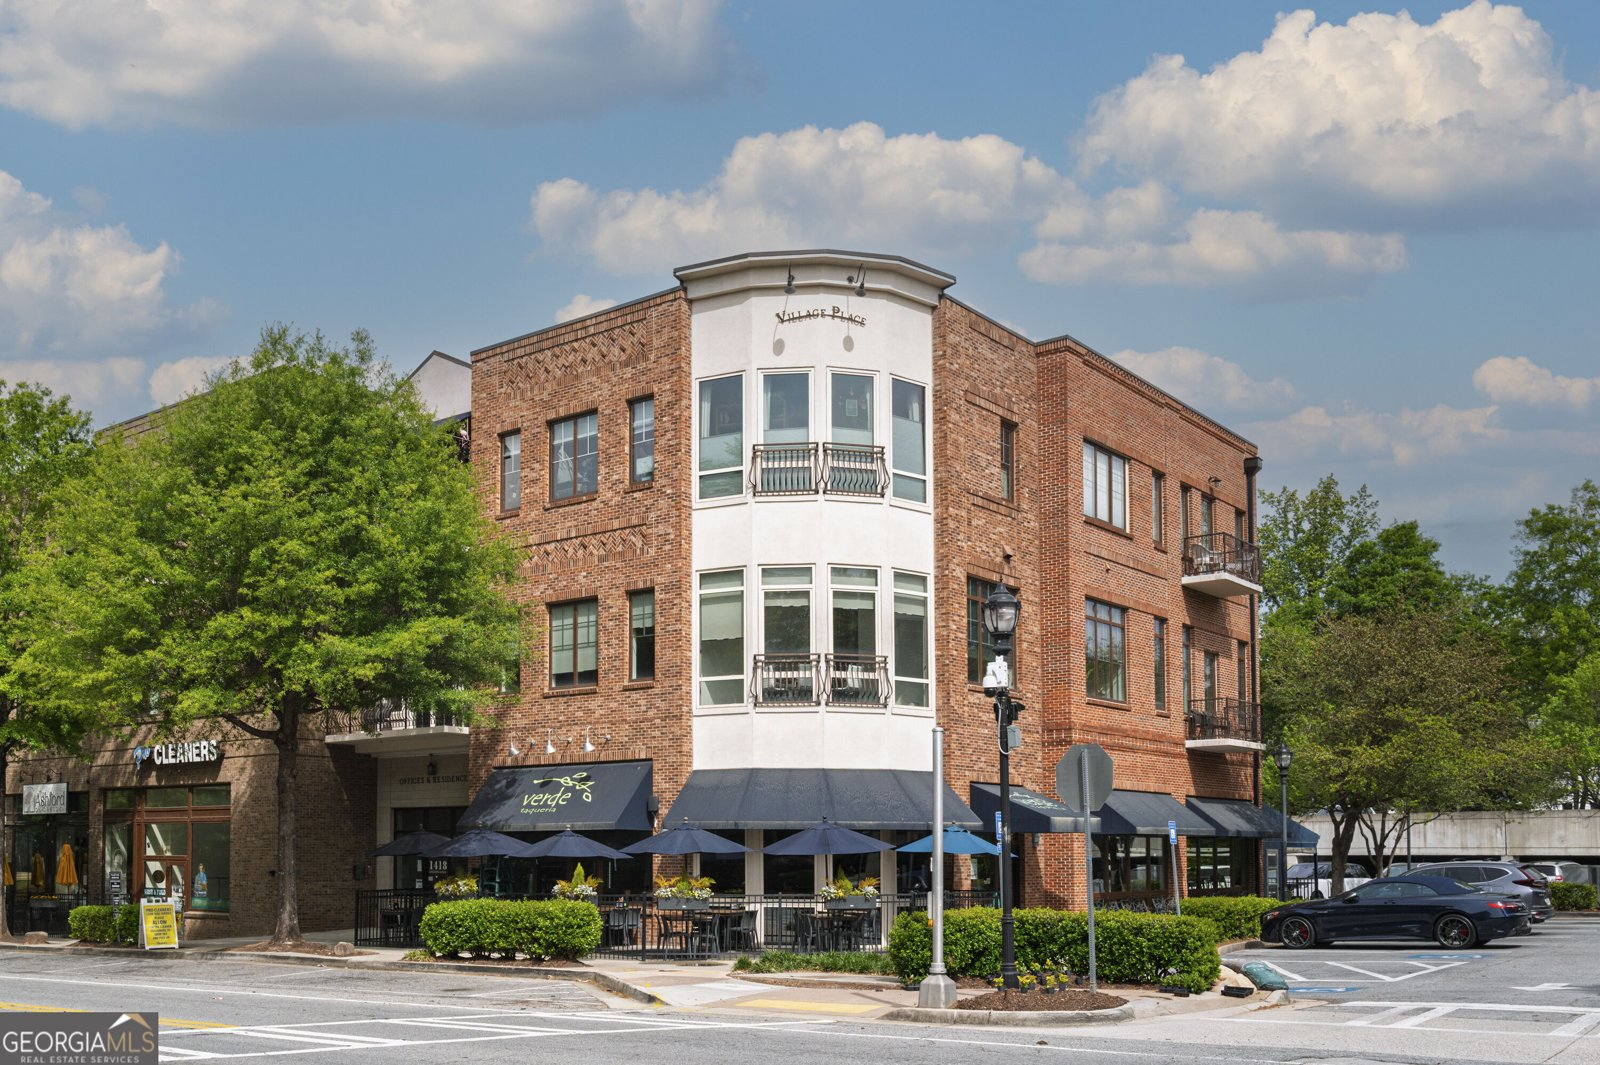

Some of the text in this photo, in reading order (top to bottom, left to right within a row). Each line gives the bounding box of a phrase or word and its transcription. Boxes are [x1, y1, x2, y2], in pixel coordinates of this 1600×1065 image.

[775, 306, 867, 327] VILLAGE PLACE
[154, 740, 217, 765] CLEANERS
[523, 787, 571, 807] verde
[521, 807, 556, 815] taqueria
[430, 861, 448, 870] 1418
